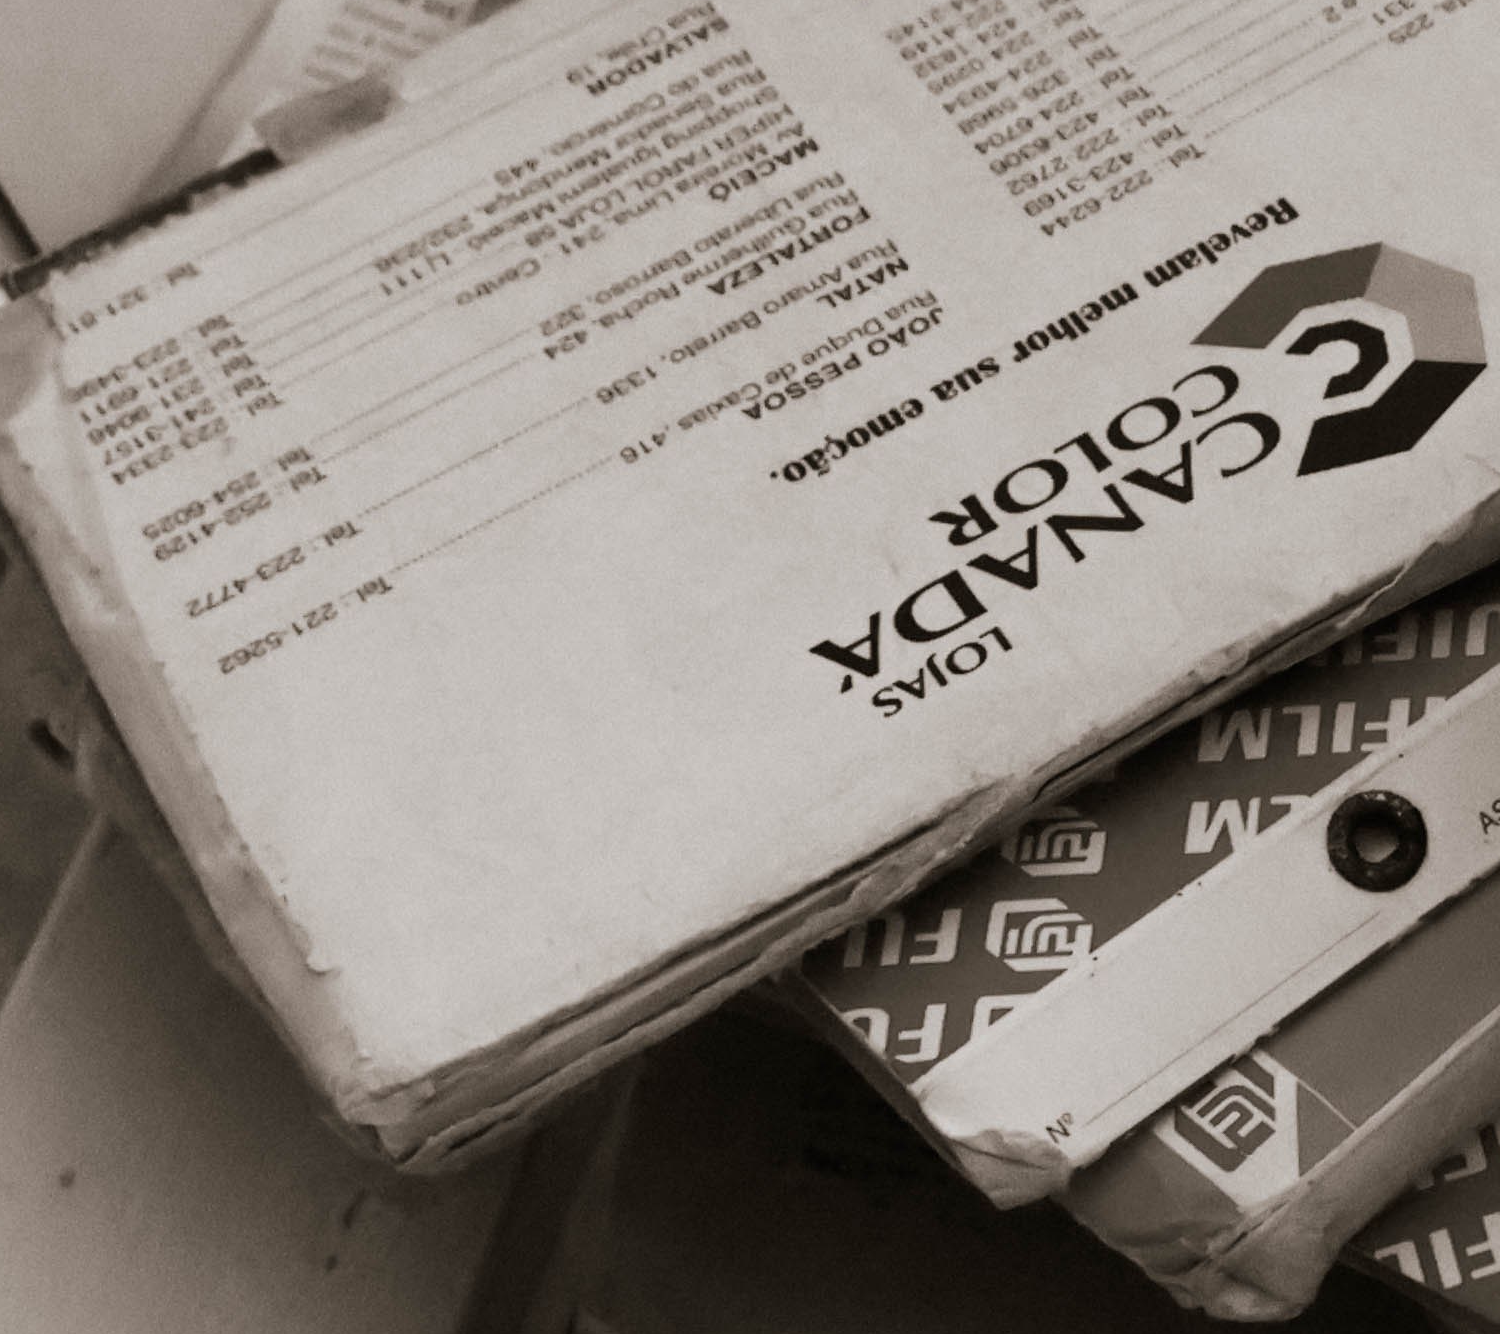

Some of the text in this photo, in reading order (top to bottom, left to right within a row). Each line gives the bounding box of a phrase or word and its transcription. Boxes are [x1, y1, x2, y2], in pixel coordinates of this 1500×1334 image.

[586, 17, 728, 95] SALVADOR
[708, 138, 818, 201] MACEIÓ
[793, 171, 844, 201] Rua
[807, 189, 858, 218] Rua
[1040, 169, 1152, 236] 222-6244
[681, 216, 806, 285] Guilherme
[707, 205, 870, 295] FORTALEZA
[817, 257, 908, 307] NATAL
[846, 239, 898, 270] Rua
[762, 266, 842, 314] Amaro
[884, 290, 937, 320] Rua
[661, 310, 762, 363] Barreto,
[741, 307, 942, 419] JOÃO PESSOA
[769, 197, 1299, 482] Revelam melhor sua emoção.
[801, 317, 885, 365] Duque
[765, 362, 796, 384] de
[677, 382, 762, 430] Caxias
[928, 364, 1239, 546] COLOR
[187, 546, 304, 617] 223-4772
[809, 411, 1281, 693] CANADÁ
[218, 602, 337, 674] 221-5262
[871, 626, 1012, 717] LOJAS
